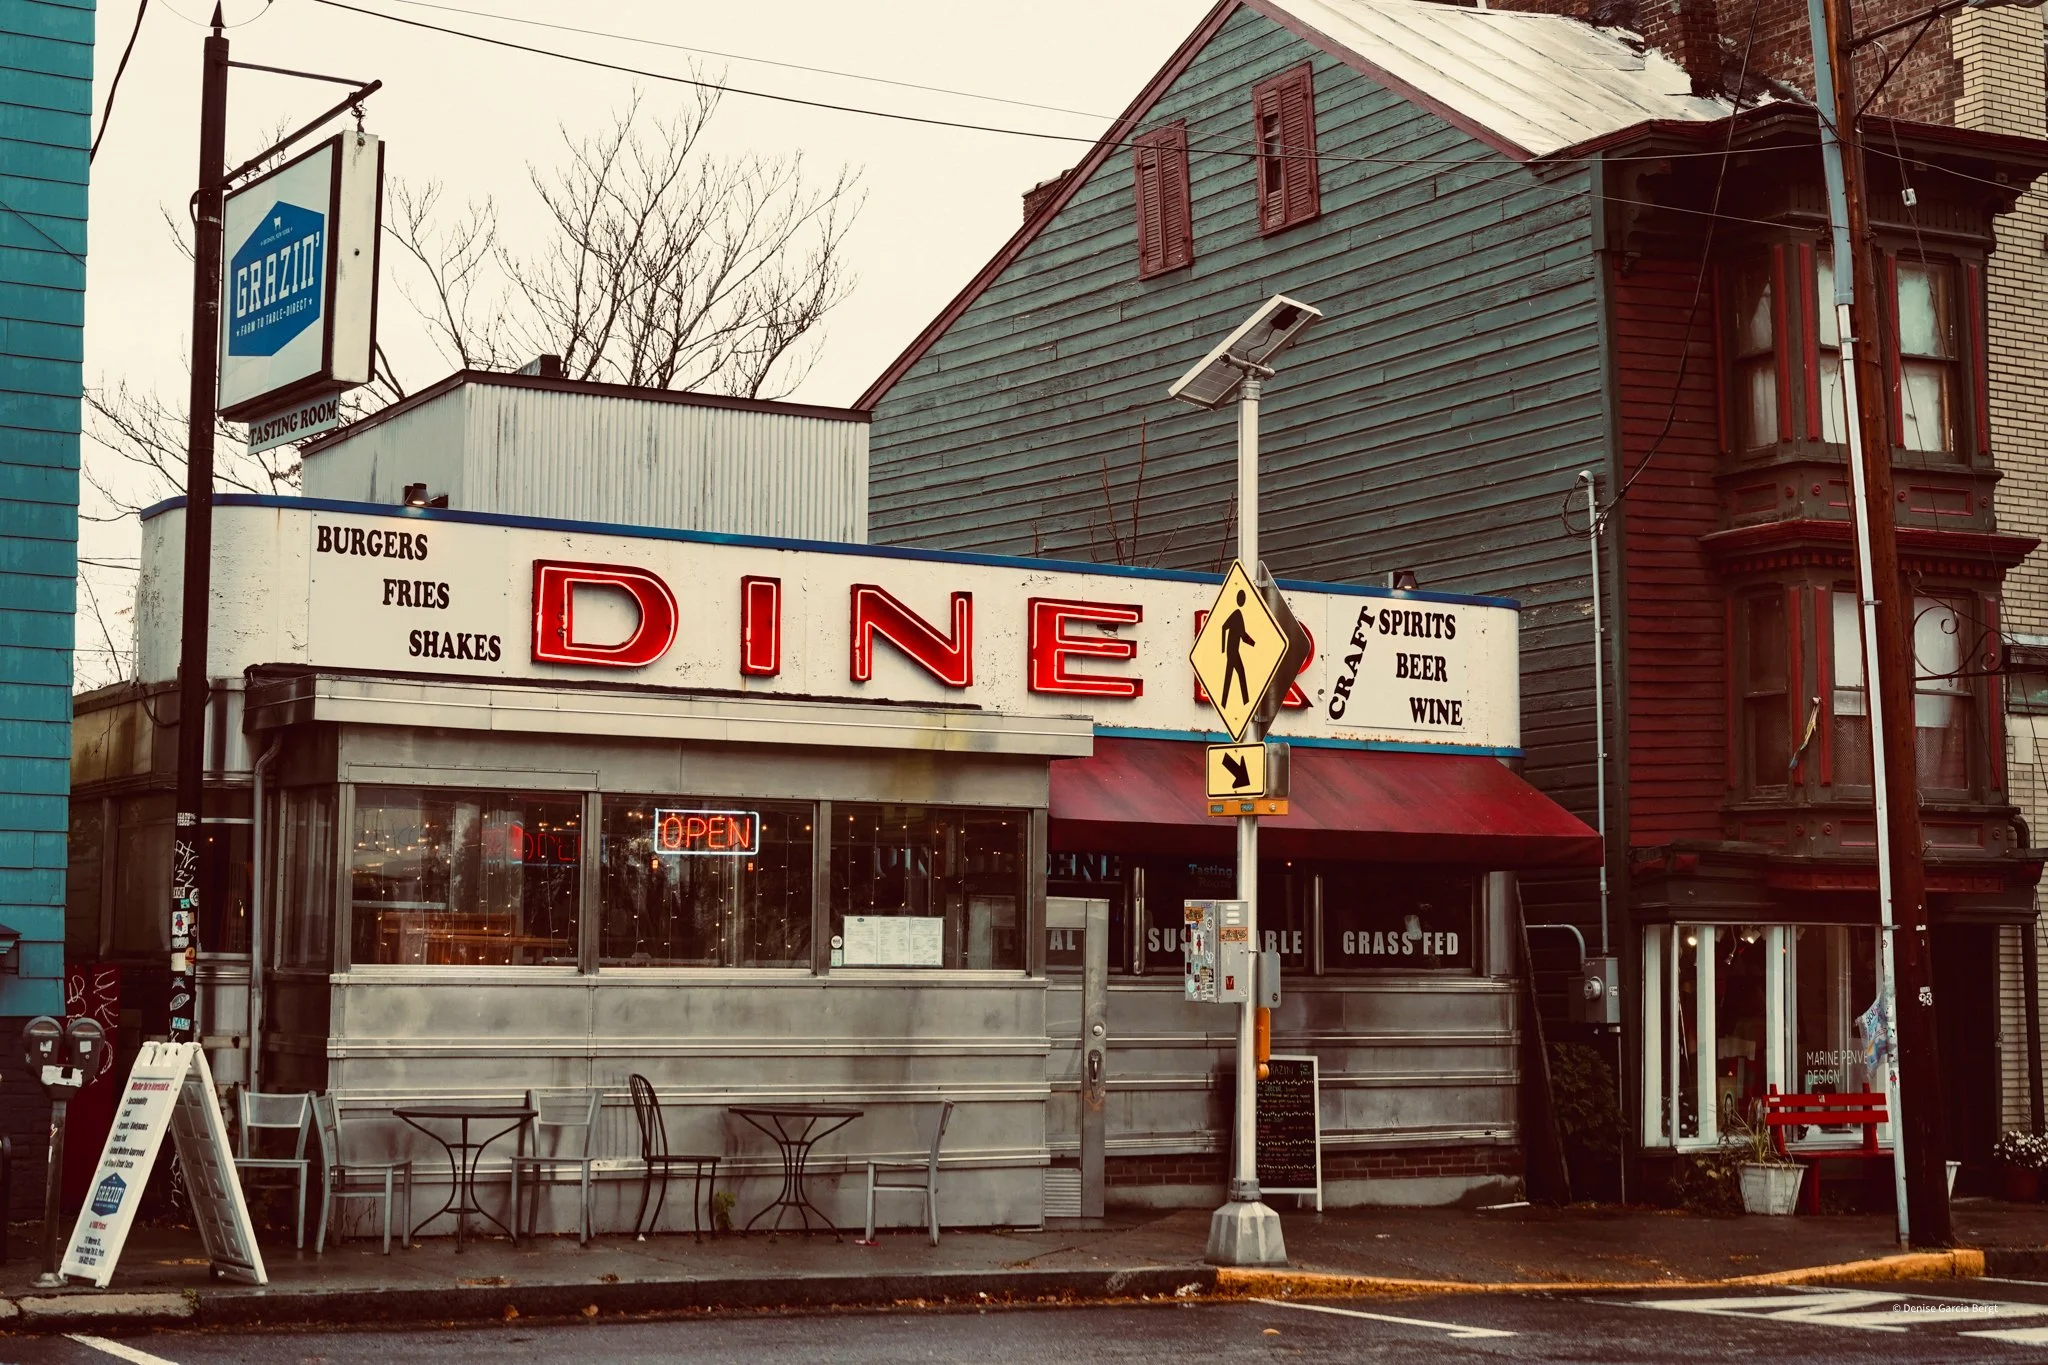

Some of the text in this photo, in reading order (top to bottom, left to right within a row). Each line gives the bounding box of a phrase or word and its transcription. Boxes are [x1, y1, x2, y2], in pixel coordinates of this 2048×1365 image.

[236, 231, 320, 319] GRAZIN'
[240, 298, 307, 336] FARM TO TABLE-DIRECT
[249, 399, 337, 447] TASTING ROOM
[316, 525, 428, 561] BURGERS
[382, 578, 450, 610] FRIES
[1378, 608, 1457, 641] SPIRITS
[408, 629, 501, 663] SHAKES
[1328, 605, 1376, 721] CRAFT
[1396, 652, 1448, 683] BEER
[1409, 696, 1463, 726] WINE
[662, 816, 750, 849] OPEN
[1343, 930, 1459, 956] GRASS FED
[1918, 992, 1933, 1007] 93
[1806, 1049, 1868, 1066] MARINE PENVE
[1807, 1069, 1840, 1085] DESIGN
